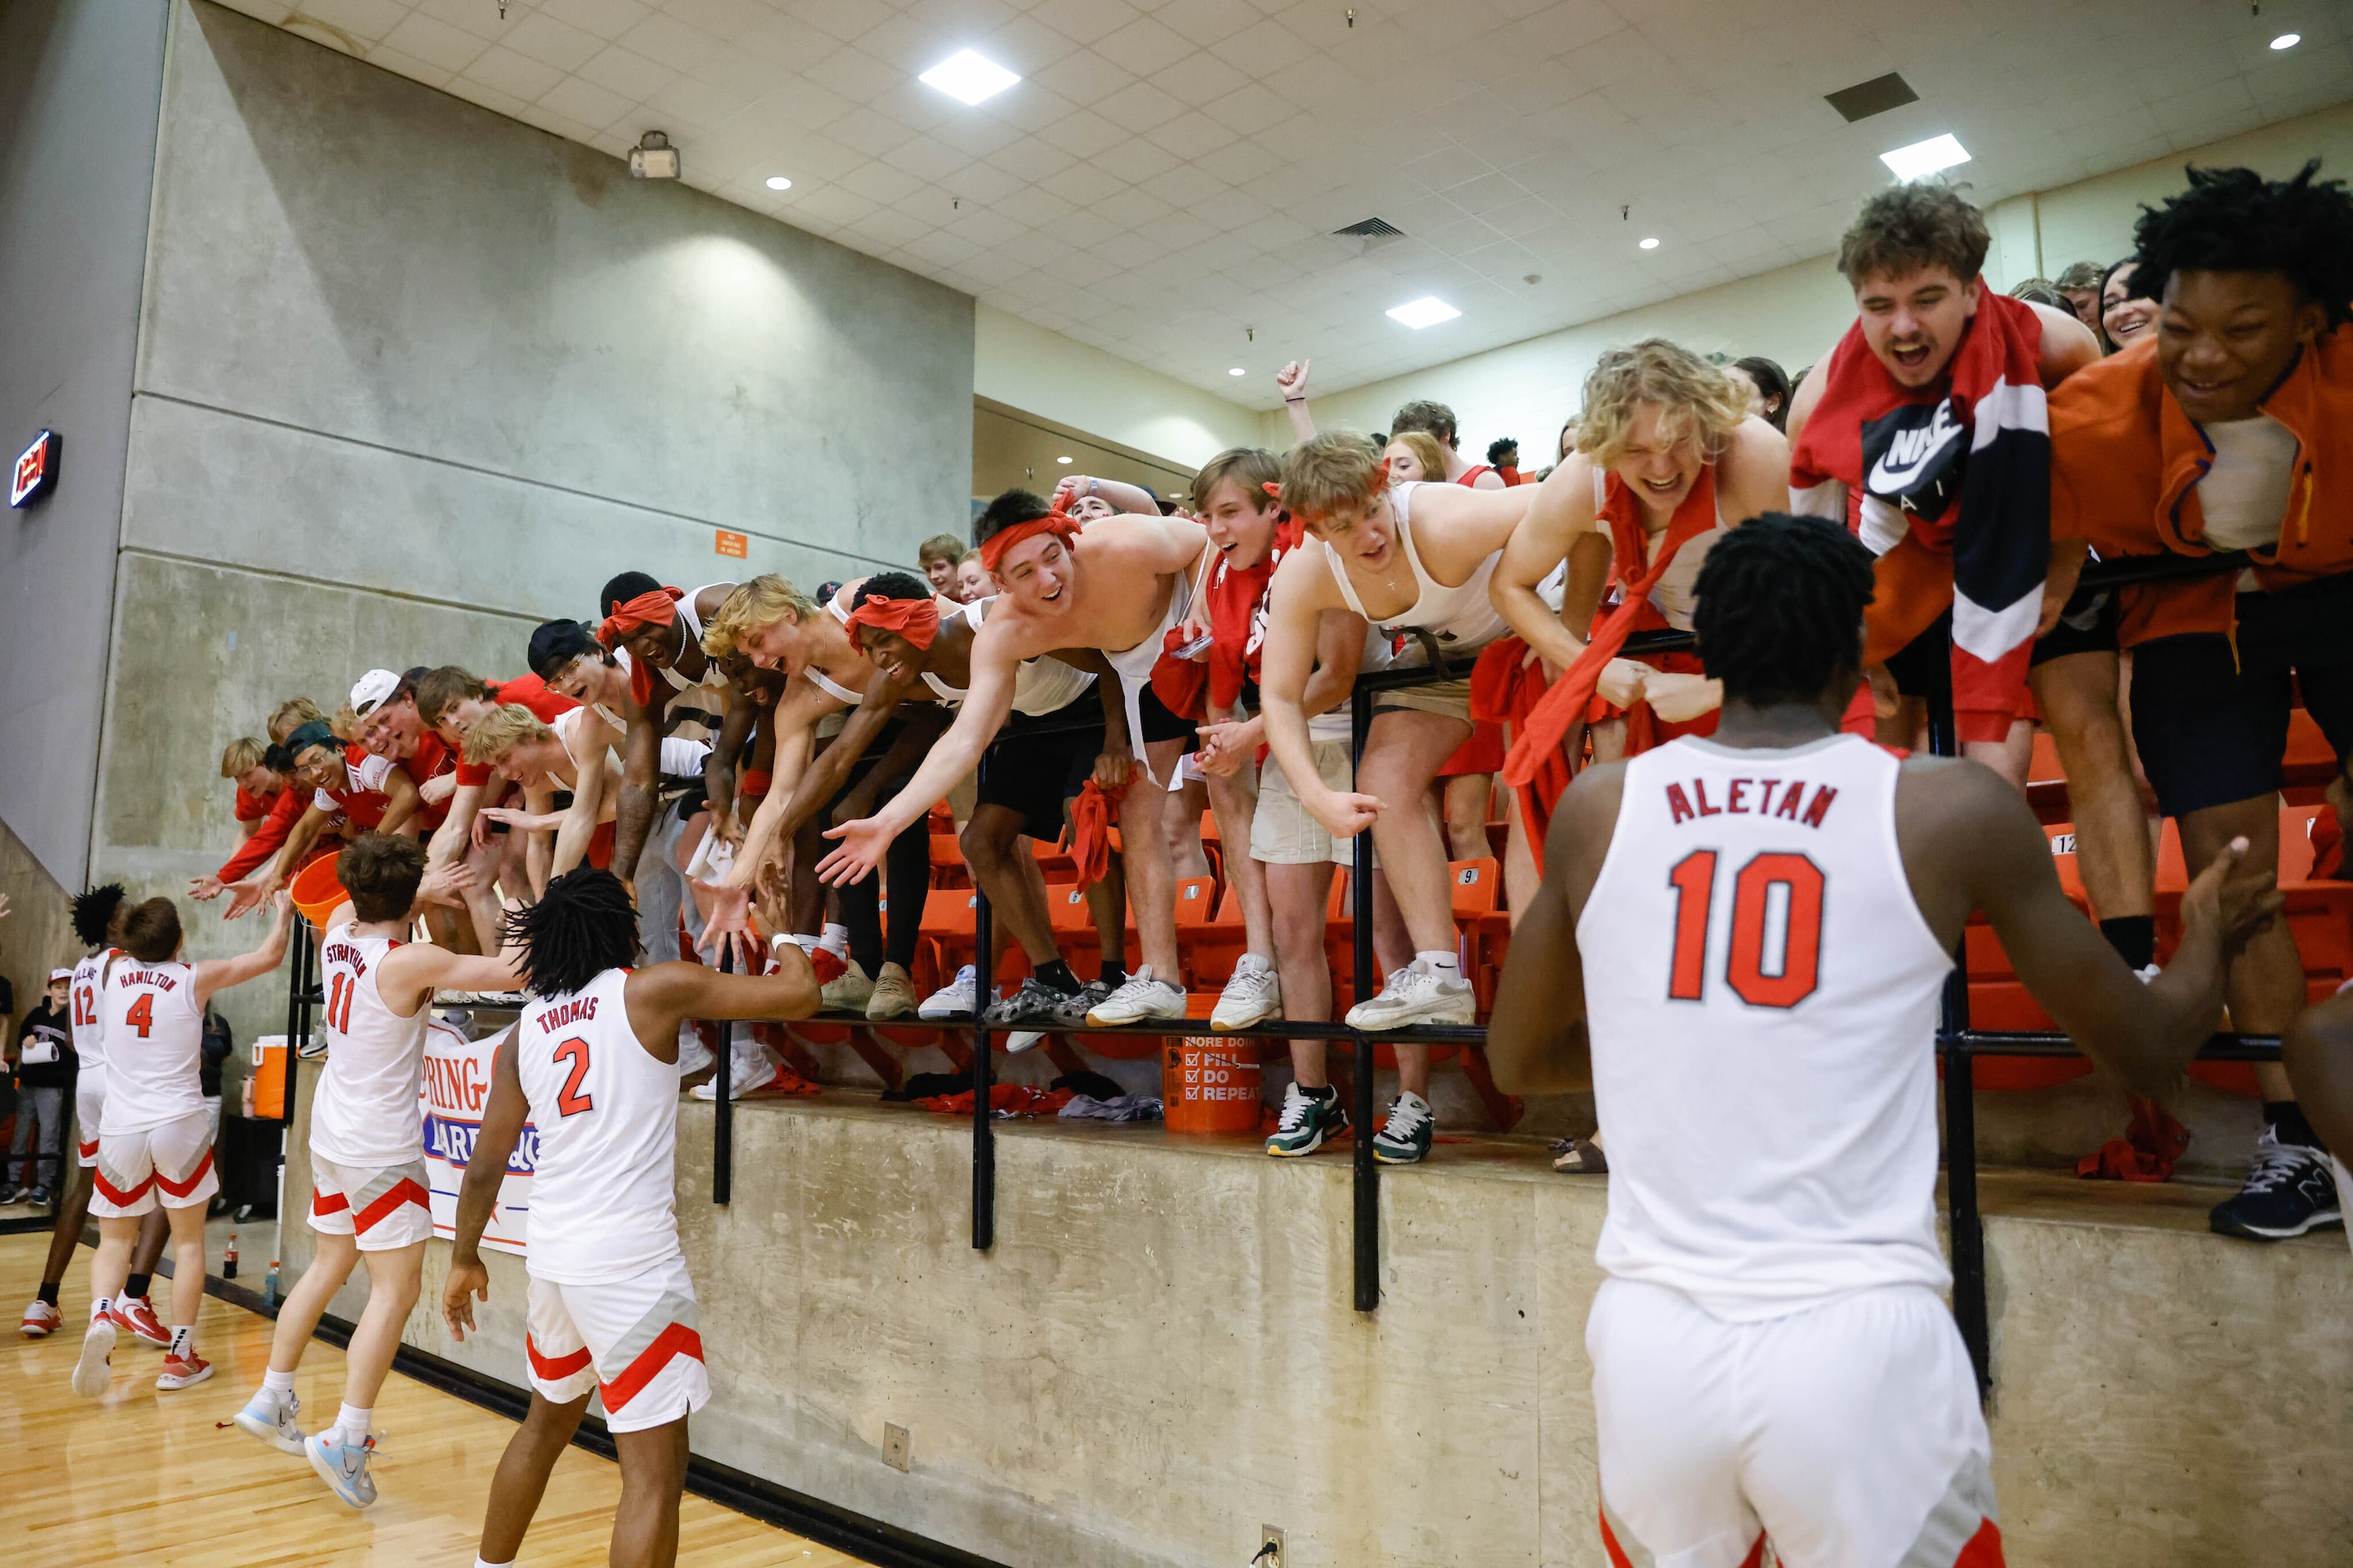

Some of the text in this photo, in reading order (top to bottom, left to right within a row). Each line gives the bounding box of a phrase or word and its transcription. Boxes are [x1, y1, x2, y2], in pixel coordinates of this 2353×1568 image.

[1665, 777, 1839, 829] ALETAN
[2060, 835, 2077, 853] 12
[1465, 869, 1472, 883] 9
[1668, 848, 1827, 1009] 10
[119, 970, 178, 993] HAMILTON
[73, 984, 98, 1027] 12
[125, 993, 154, 1039] 4
[328, 971, 356, 1035] 11
[536, 996, 599, 1034] THOMAS
[1185, 1036, 1223, 1048] MORE
[1203, 1052, 1240, 1068] FILL
[552, 1035, 594, 1118] 2
[1203, 1069, 1230, 1085] DO
[1203, 1086, 1262, 1101] REPEAT
